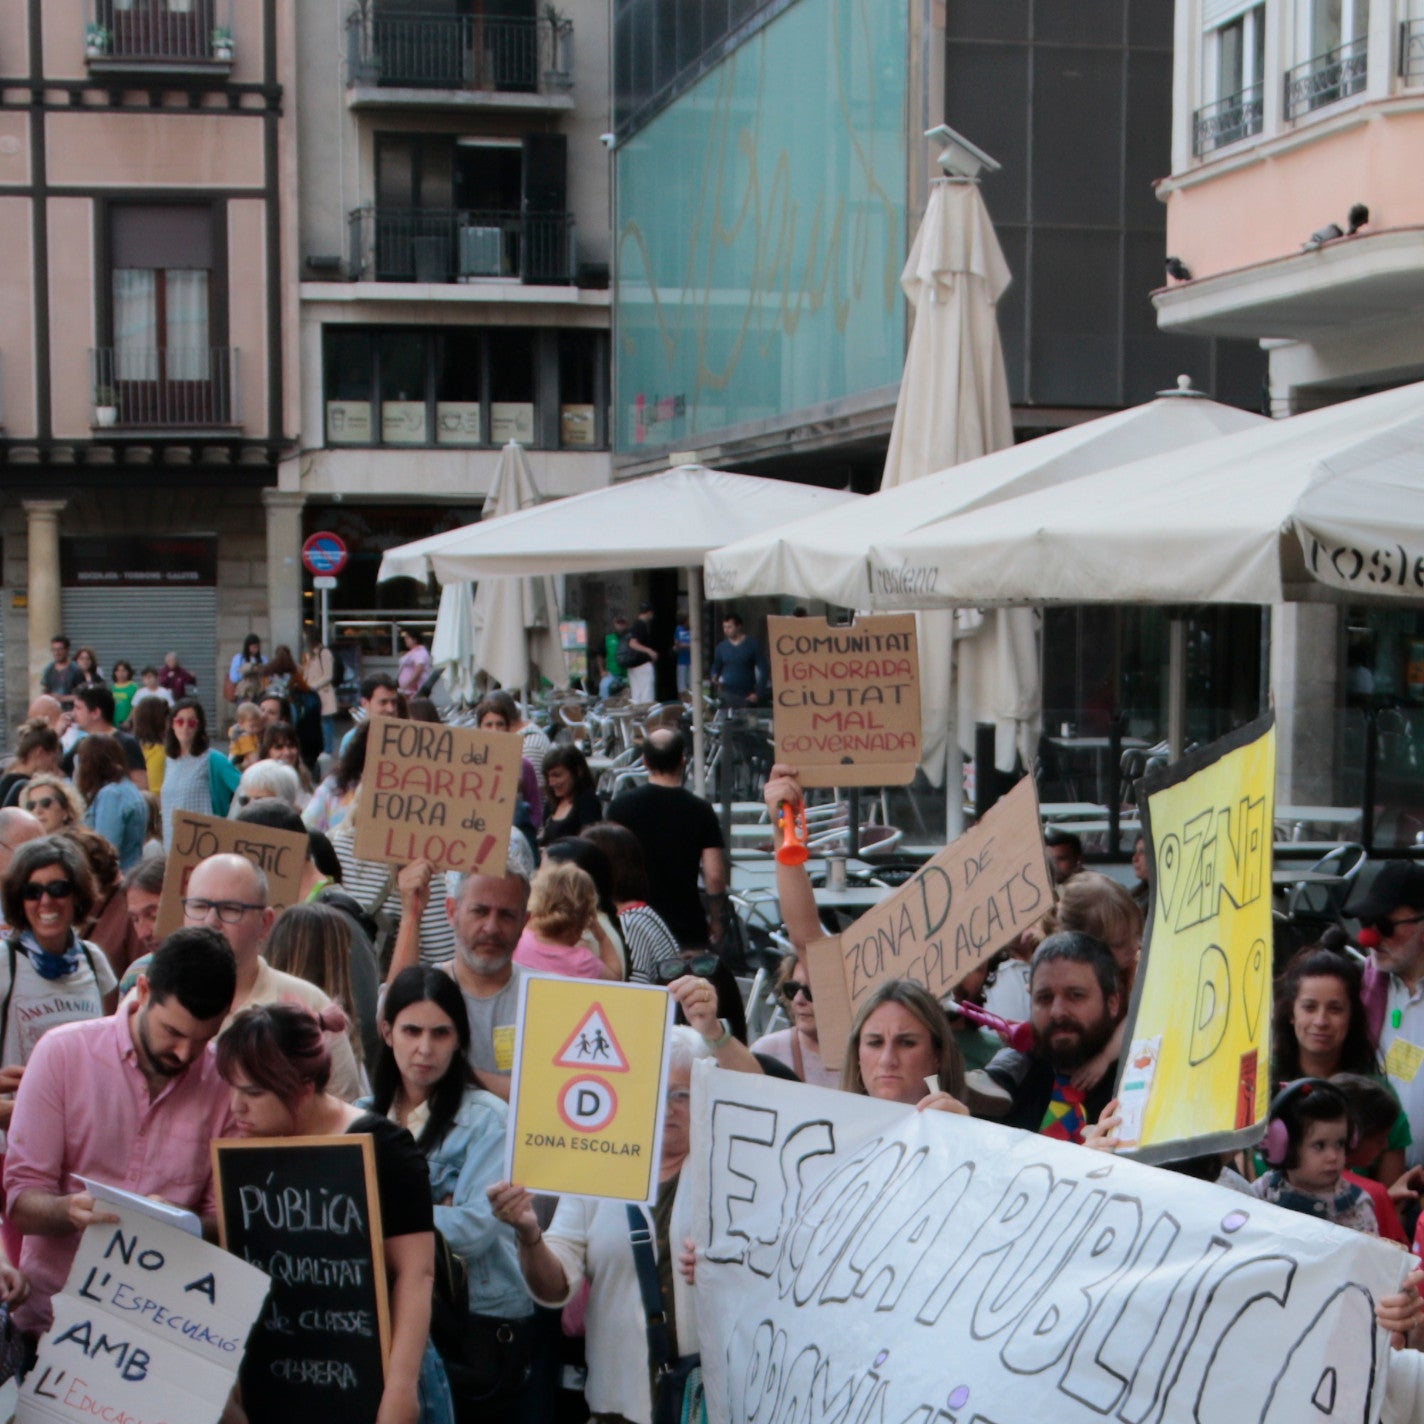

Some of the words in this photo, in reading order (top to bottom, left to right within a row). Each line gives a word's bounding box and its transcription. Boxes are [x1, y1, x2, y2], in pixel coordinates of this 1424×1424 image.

[812, 711, 884, 731] MAL
[381, 724, 455, 764] FORA
[461, 741, 490, 766] del
[372, 792, 446, 827] FORA
[461, 808, 486, 832] de
[176, 819, 219, 860] JO
[845, 903, 917, 1001] ZONA
[963, 836, 996, 891] DE
[1189, 944, 1231, 1067] D
[577, 1089, 600, 1116] D
[525, 1133, 566, 1149] ZONA
[571, 1137, 641, 1157] ESCOLAR
[708, 1100, 976, 1315] ESCOLA
[184, 1272, 216, 1305] A
[299, 1309, 373, 1337] CLASSE
[52, 1320, 151, 1382] AMB
[270, 1358, 357, 1389] OBRERA
